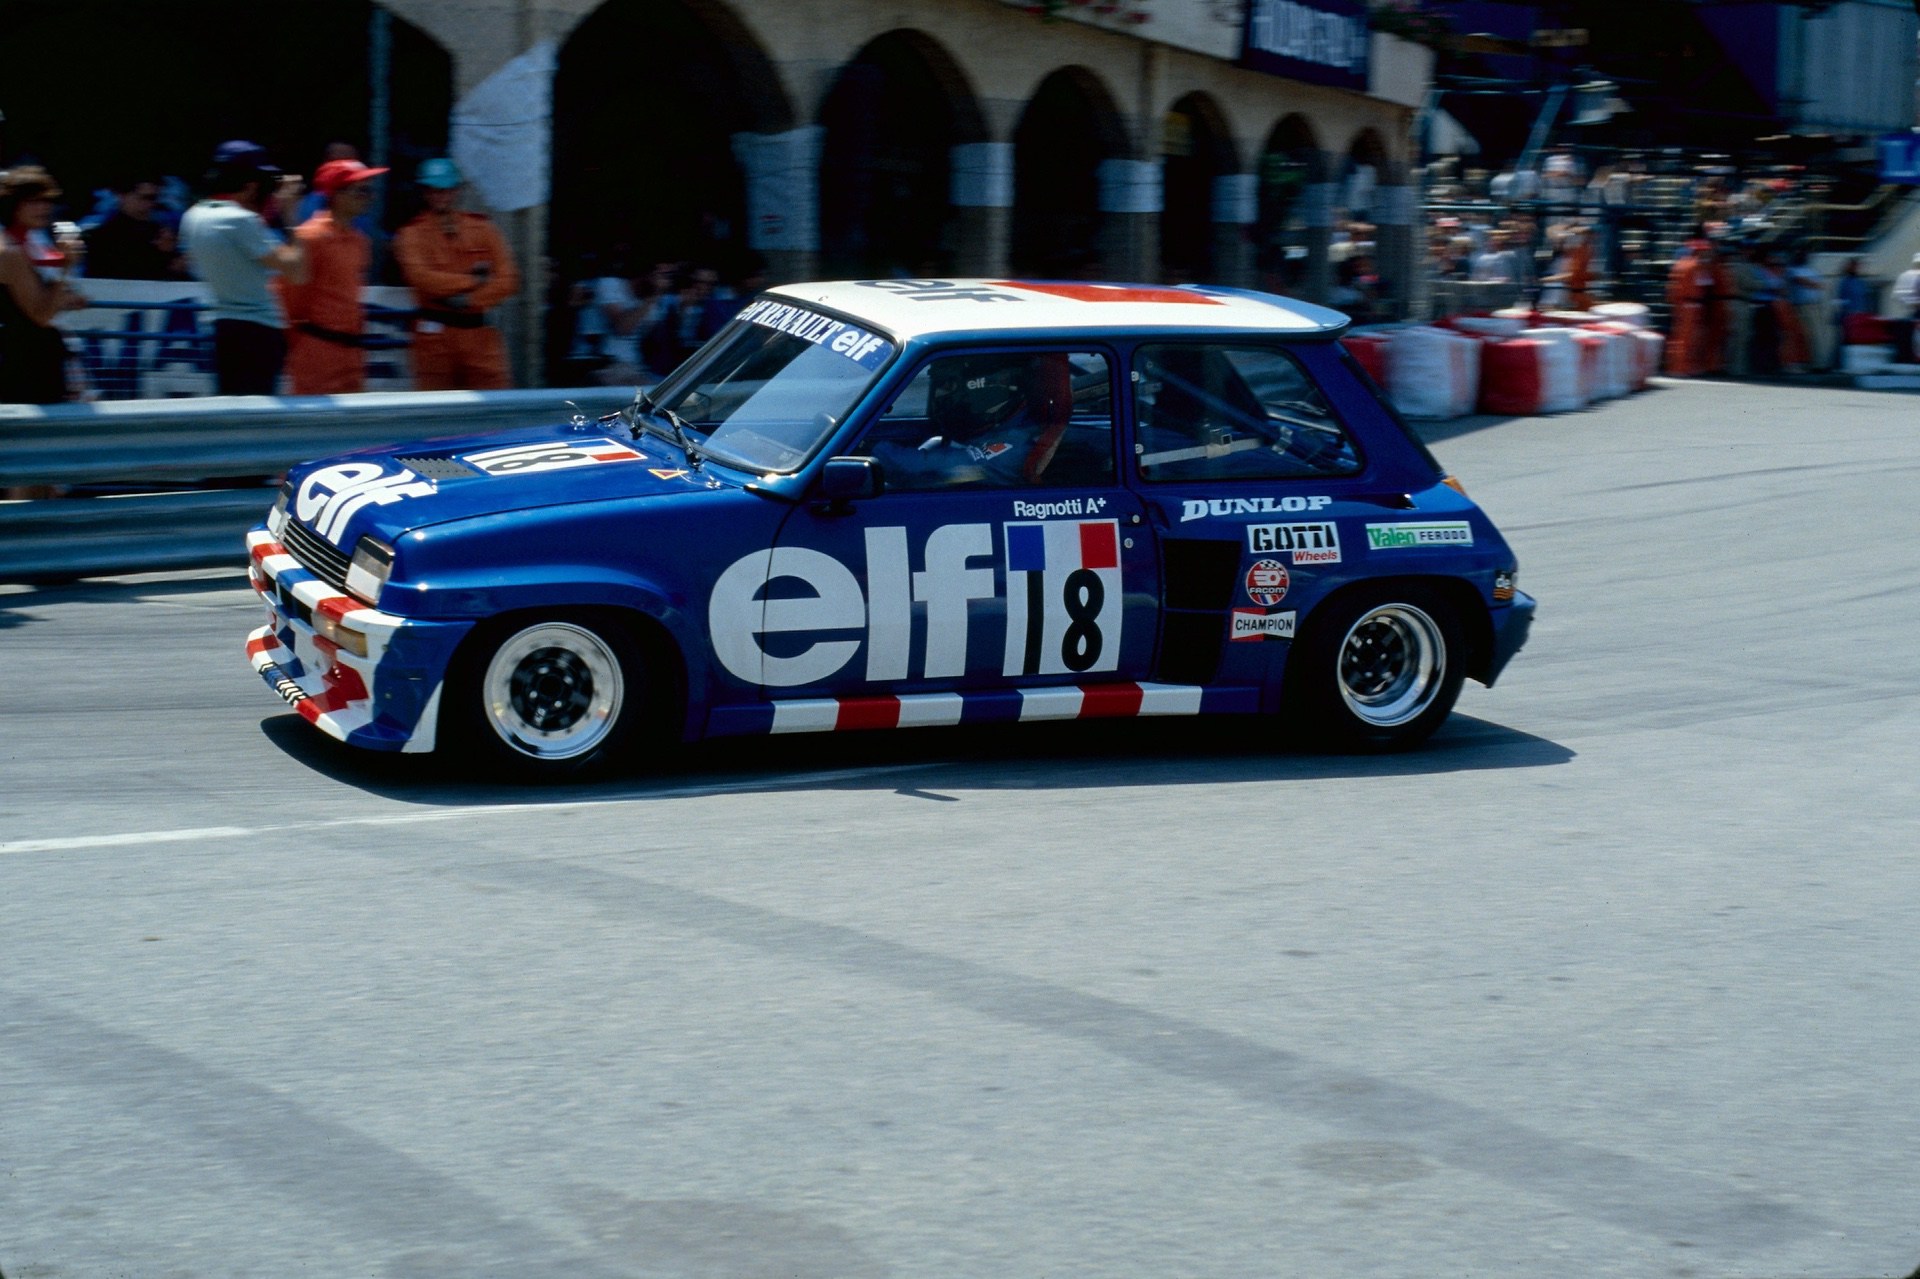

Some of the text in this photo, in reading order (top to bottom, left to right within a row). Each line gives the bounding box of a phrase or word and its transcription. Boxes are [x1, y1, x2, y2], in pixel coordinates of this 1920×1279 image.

[854, 279, 1026, 302] elf
[753, 301, 846, 345] RENAULT
[832, 330, 884, 362] elf
[967, 377, 985, 389] elf
[470, 446, 588, 472] 18
[296, 463, 437, 546] elf
[1014, 497, 1107, 519] Ragnotti A+
[1180, 496, 1332, 522] DUNLOP
[1253, 524, 1336, 551] GOTTI
[1419, 530, 1467, 541] FERODO
[1294, 550, 1338, 562] Wheels
[708, 523, 995, 687] elf
[1022, 568, 1105, 675] 18
[1235, 618, 1293, 631] CHAMPION
